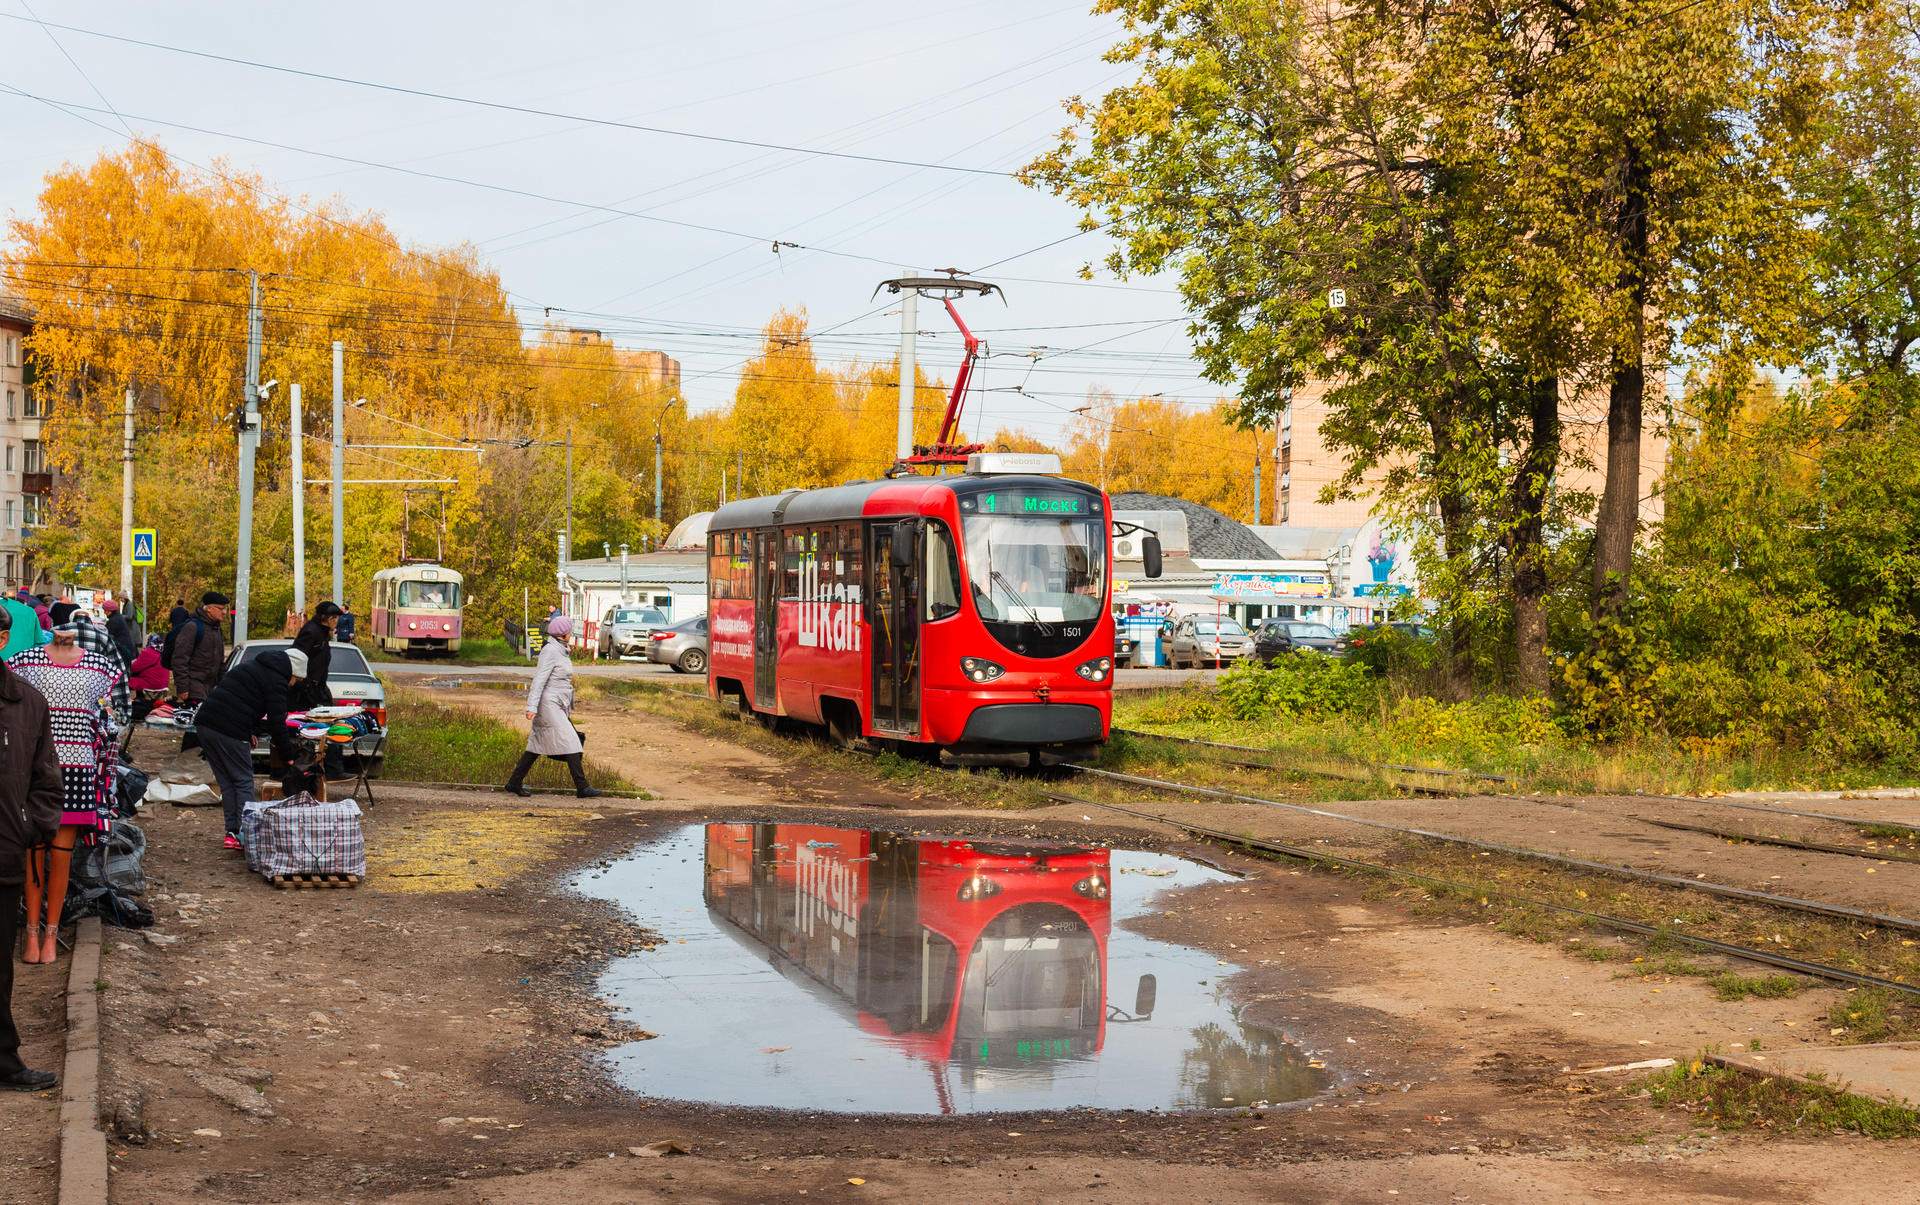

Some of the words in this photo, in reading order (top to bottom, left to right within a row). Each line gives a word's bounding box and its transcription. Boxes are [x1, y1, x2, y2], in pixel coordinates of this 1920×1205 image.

[1331, 291, 1344, 305] 15
[1003, 457, 1041, 465] Webasto
[985, 494, 996, 512] 1
[1219, 575, 1276, 596] Хозяйка
[798, 560, 861, 652] Шкап
[420, 620, 438, 629] 2053
[1063, 627, 1081, 637] 1501
